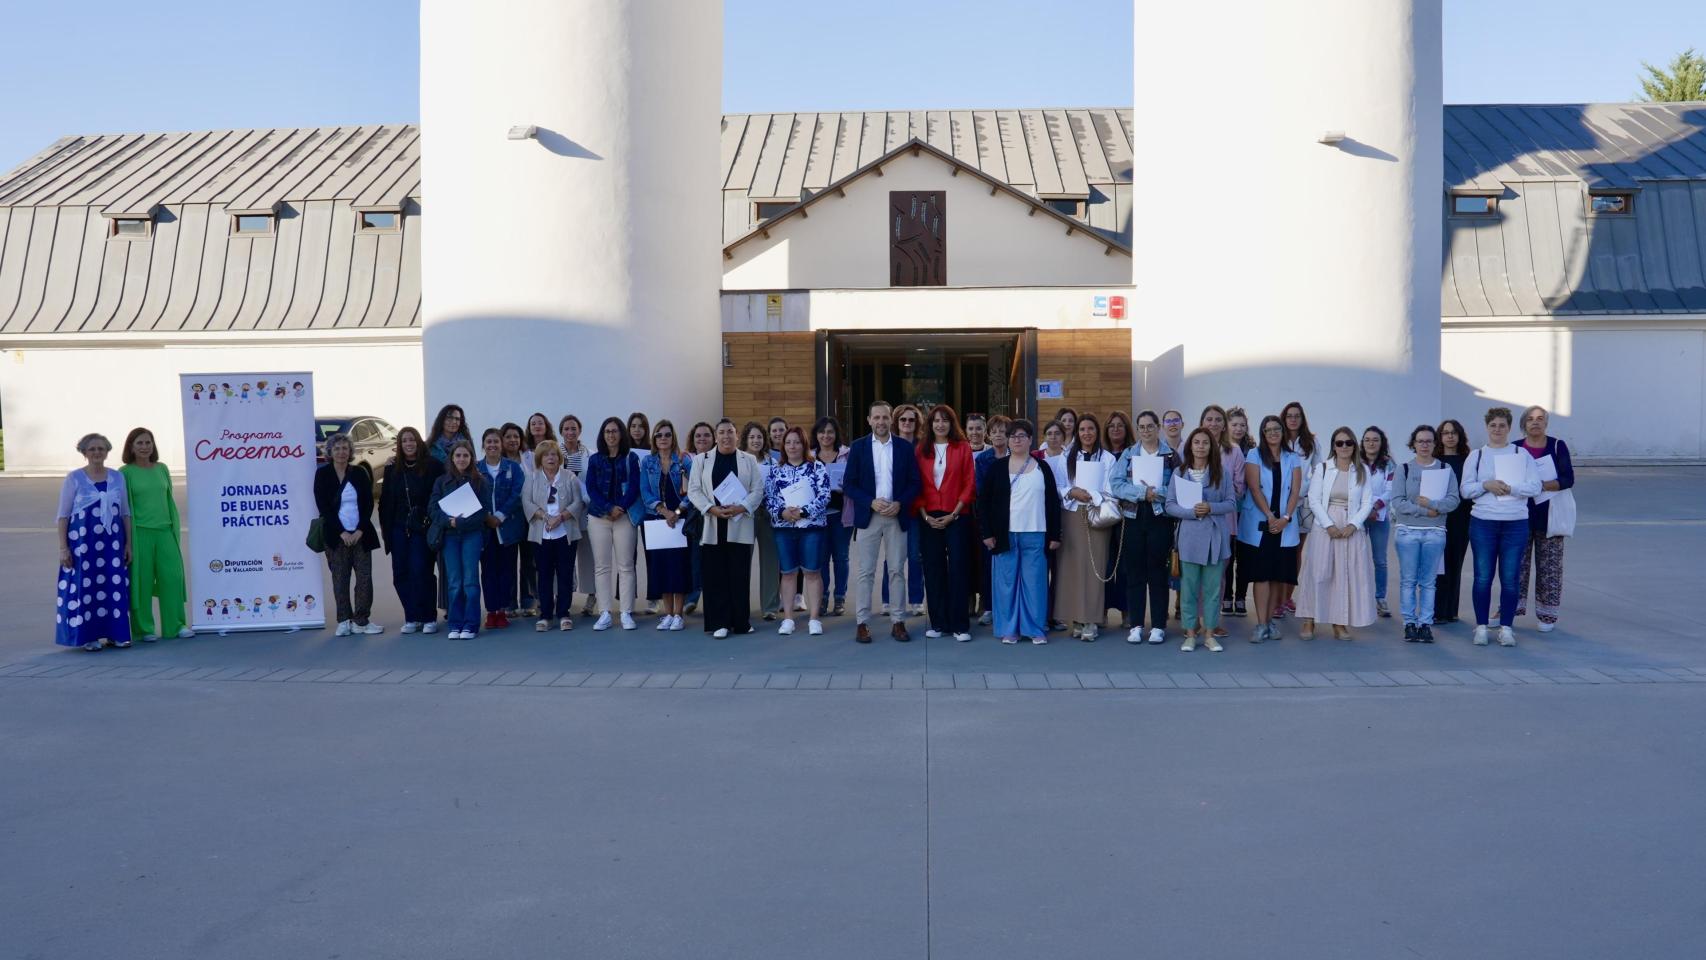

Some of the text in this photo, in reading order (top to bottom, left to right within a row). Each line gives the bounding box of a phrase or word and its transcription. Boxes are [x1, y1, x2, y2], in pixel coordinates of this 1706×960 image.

[220, 429, 283, 443] Programa
[195, 439, 305, 461] Crecemos
[221, 484, 287, 497] JORNADAS
[221, 499, 289, 512] DE BUENAS
[222, 514, 290, 527] PRÁCTICAS
